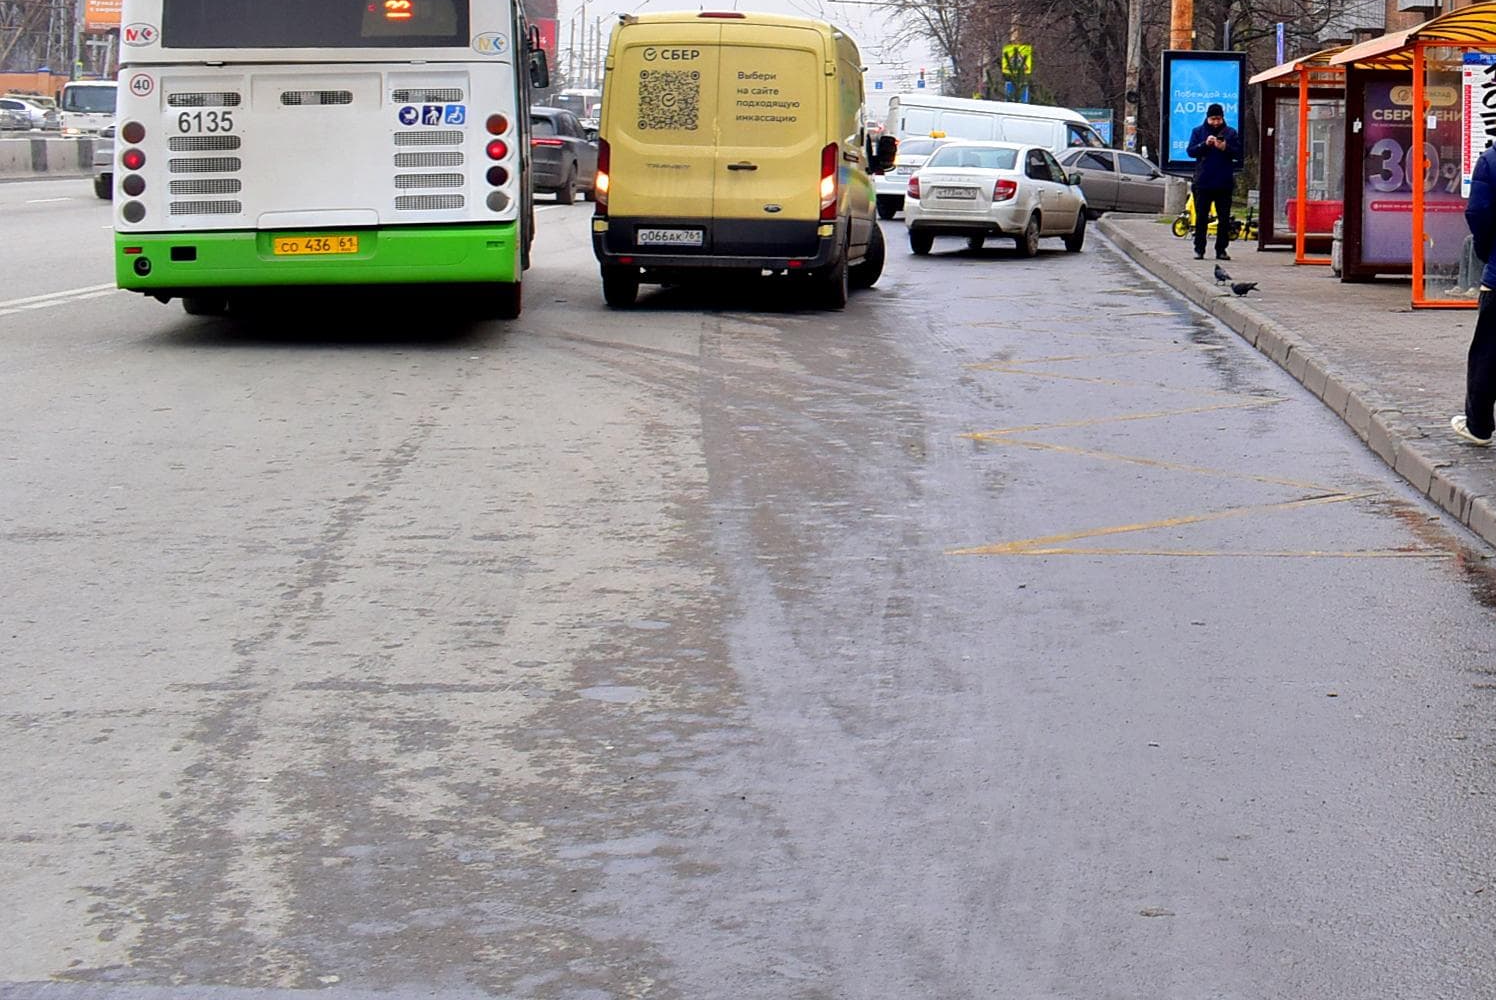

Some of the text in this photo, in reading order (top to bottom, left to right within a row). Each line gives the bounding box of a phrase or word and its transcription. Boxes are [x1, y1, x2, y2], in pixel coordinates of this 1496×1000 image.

[661, 49, 700, 61] СБЕР
[737, 71, 777, 81] Выбери
[133, 79, 150, 91] 40
[737, 86, 780, 96] на сайте
[736, 99, 801, 110] подходящую
[177, 110, 234, 133] 6135
[735, 114, 798, 123] инкассацию
[304, 238, 331, 252] 436
